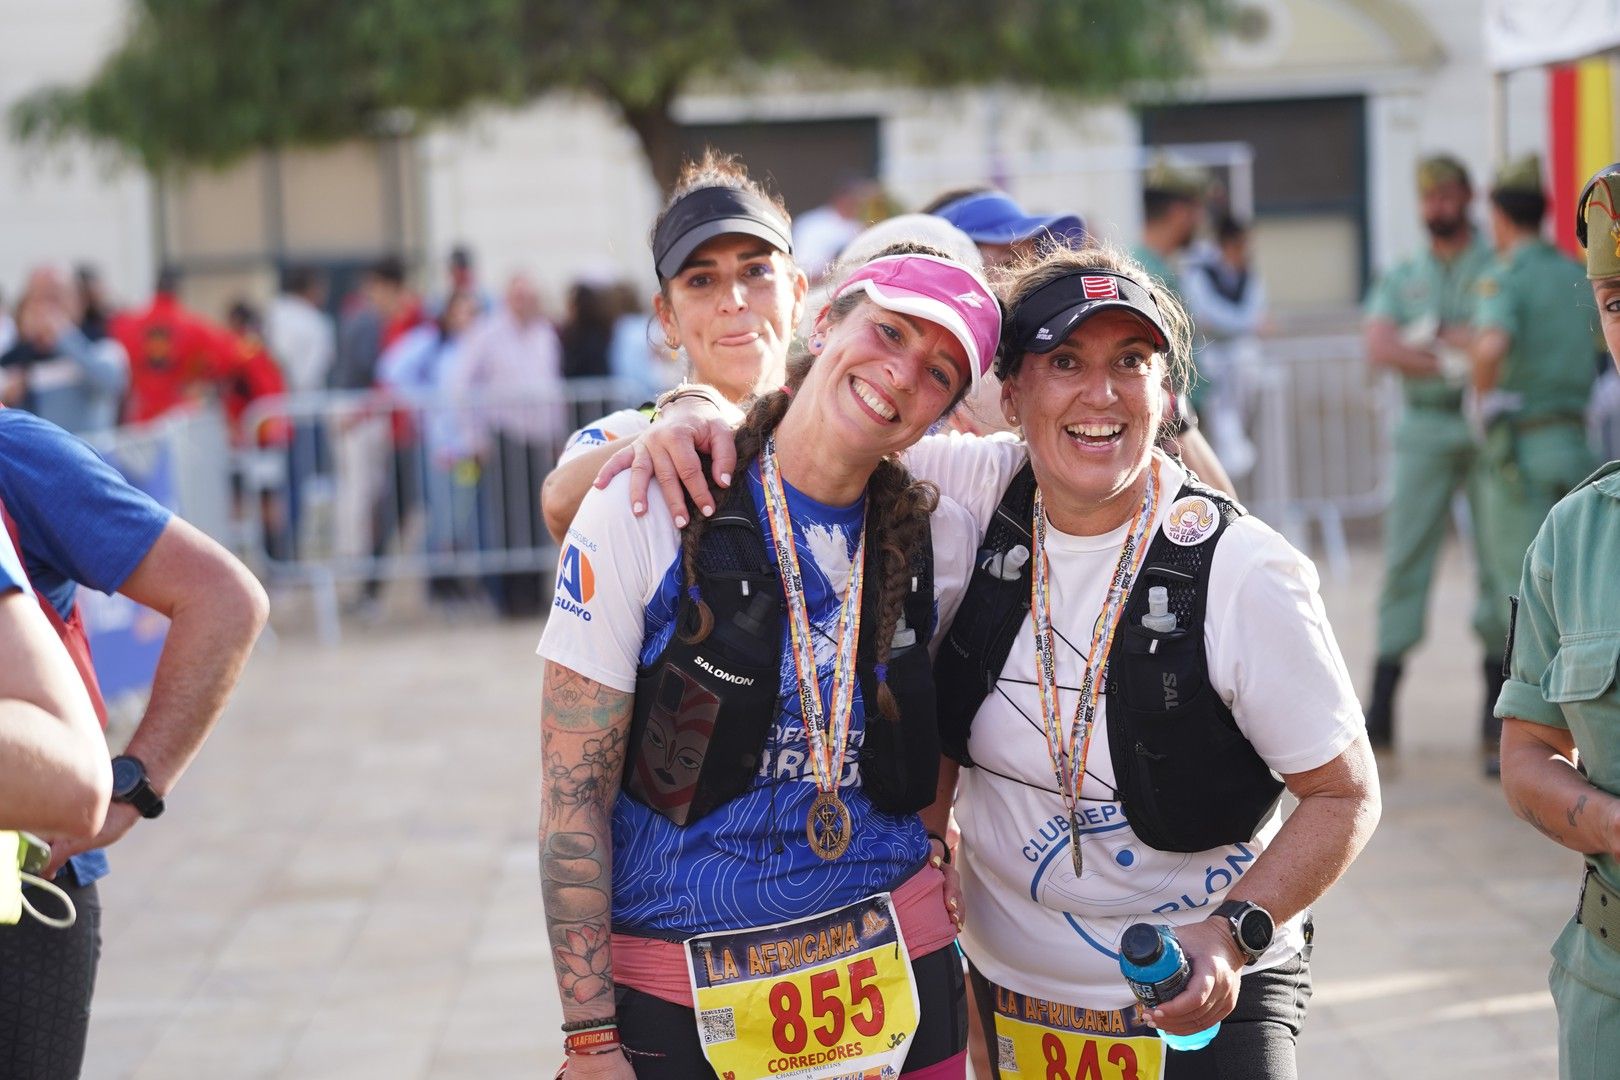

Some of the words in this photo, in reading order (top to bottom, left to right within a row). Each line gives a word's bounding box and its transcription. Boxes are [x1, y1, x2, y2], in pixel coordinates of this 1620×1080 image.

[779, 546, 794, 594] AFRICANA
[1112, 542, 1136, 588] AFRICANA
[693, 655, 755, 687] SALOMON
[1042, 633, 1054, 679] AFRICANA
[801, 685, 815, 733] AFRICANA
[1077, 674, 1094, 721] AFRICANA
[1022, 814, 1072, 863] CLUB
[1076, 804, 1128, 827] DEP
[704, 946, 740, 983] LA
[749, 921, 860, 977] AFRICANA
[768, 956, 885, 1055] 855
[997, 986, 1018, 1015] LA
[1025, 996, 1126, 1034] AFRICANA
[579, 1031, 614, 1046] AFRICANA
[767, 1041, 863, 1074] CORREDORES
[1041, 1032, 1139, 1080] 843
